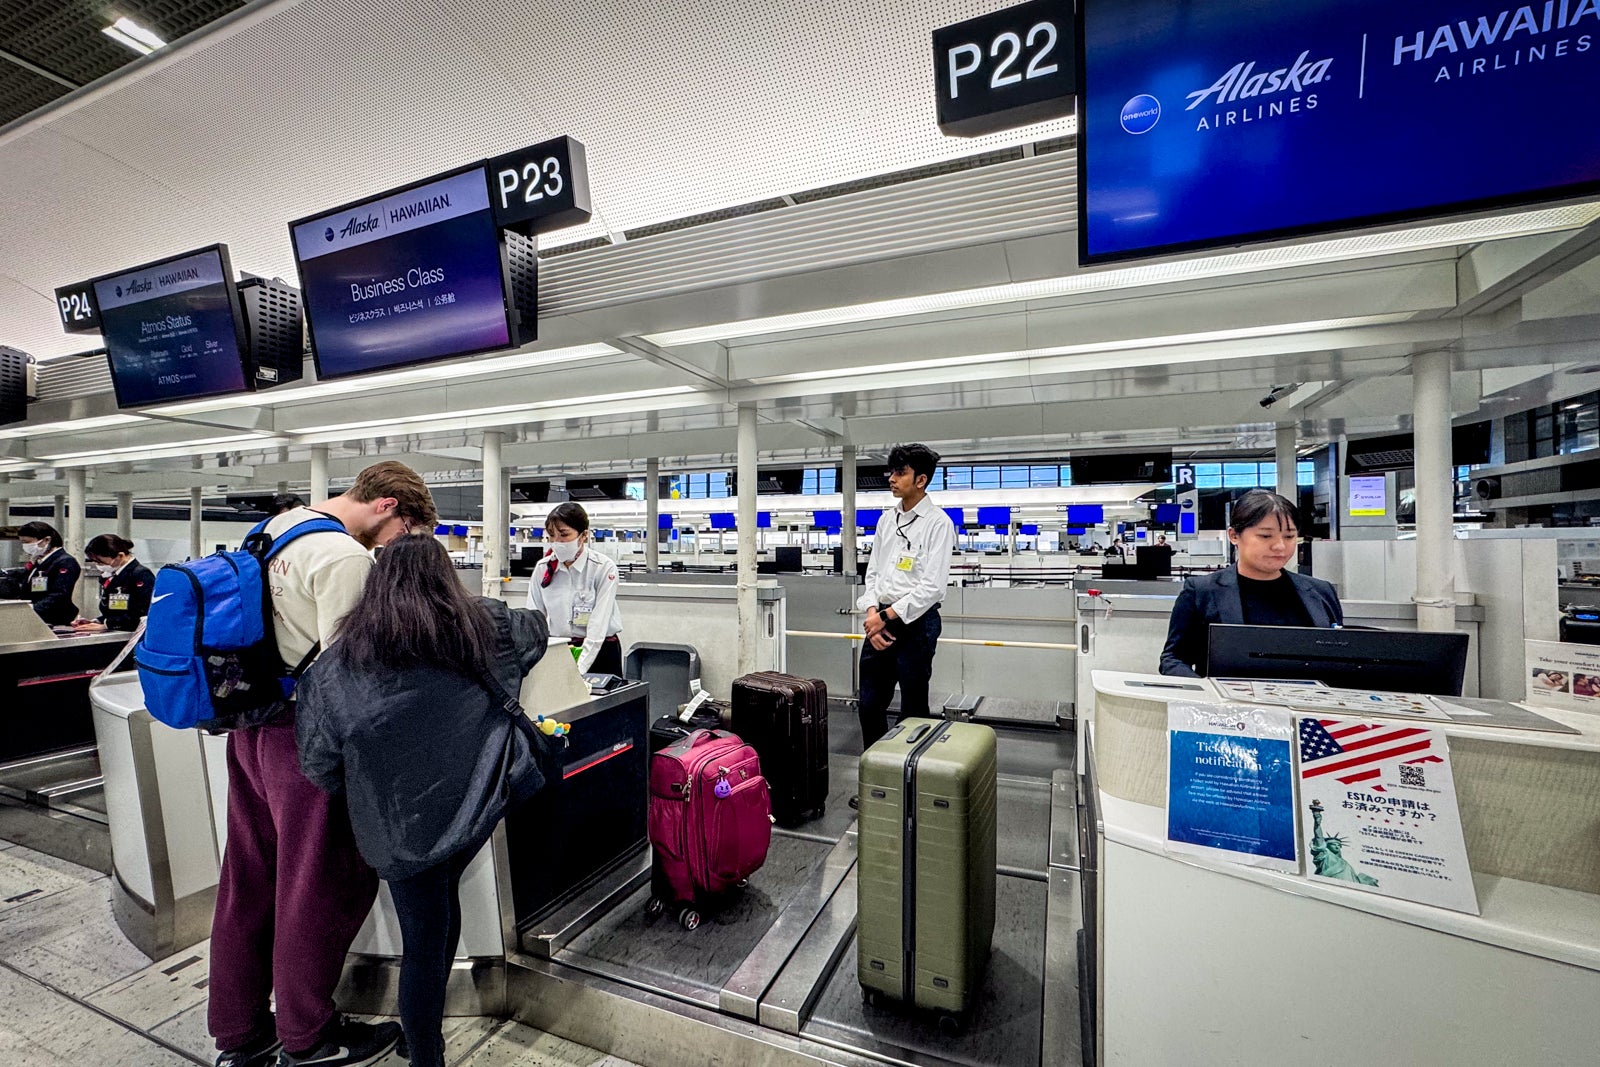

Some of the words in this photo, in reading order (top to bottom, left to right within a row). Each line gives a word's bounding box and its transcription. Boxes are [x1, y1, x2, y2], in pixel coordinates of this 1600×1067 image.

[948, 21, 1058, 99] P22
[1434, 35, 1591, 82] AIRLINES
[1185, 49, 1333, 110] Alaska
[1122, 106, 1159, 121] oneworld
[1196, 94, 1318, 131] AIRLINES
[498, 156, 563, 209] P23
[340, 213, 379, 239] Alaska
[390, 193, 451, 223] HAWAIIAN
[126, 277, 152, 296] Alaska
[158, 267, 199, 287] HAWAIIAN
[350, 276, 405, 302] Business
[407, 266, 444, 289] Class
[60, 291, 92, 323] P24
[349, 308, 386, 324] ビジネスクラス
[393, 299, 424, 314] 비즈니스석
[141, 320, 167, 335] Atmos
[166, 315, 192, 330] Status
[158, 374, 180, 385] ATMOS
[1179, 468, 1193, 484] R
[1341, 800, 1437, 822] お済みですか？
[1346, 791, 1431, 811] ESTAの申請は
